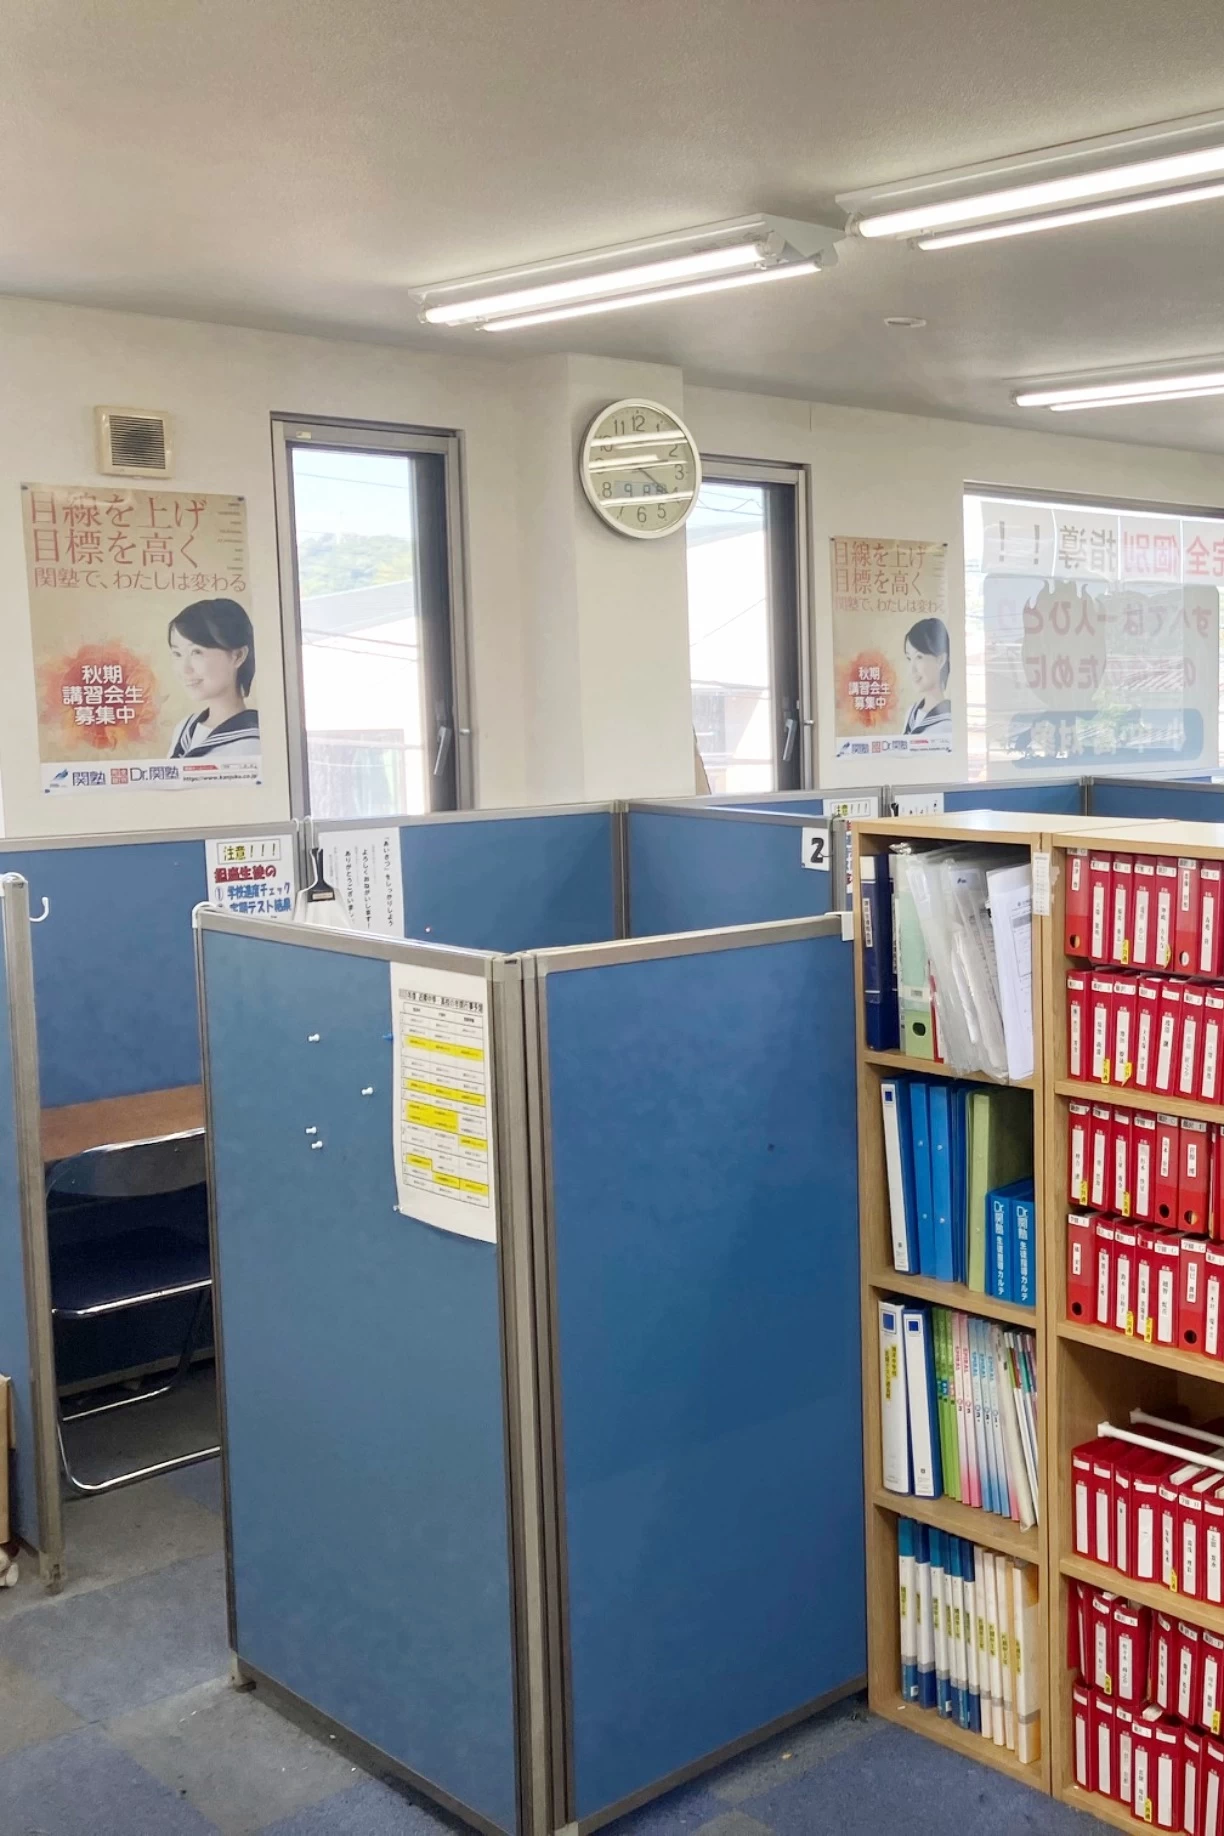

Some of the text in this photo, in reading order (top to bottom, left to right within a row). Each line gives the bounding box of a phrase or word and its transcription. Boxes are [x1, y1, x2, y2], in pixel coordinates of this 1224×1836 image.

[632, 415, 645, 431] 12
[675, 464, 684, 480] 3
[602, 482, 612, 498] 8
[31, 491, 207, 531] 目線を上げ
[637, 507, 646, 522] 6
[33, 528, 198, 568] 目標を高く
[834, 541, 926, 569] 目線を上げ
[34, 567, 246, 592] 関塾で、わたしは変わる
[836, 569, 922, 596] 目標を高く
[81, 665, 123, 684] 秋期
[858, 666, 881, 680] 秋期
[62, 685, 144, 705] 講習会生
[848, 681, 891, 695] 講習会生
[854, 696, 886, 710] 募集中
[74, 706, 136, 725] 募集中
[72, 771, 106, 786] 関塾
[810, 837, 825, 863] 2
